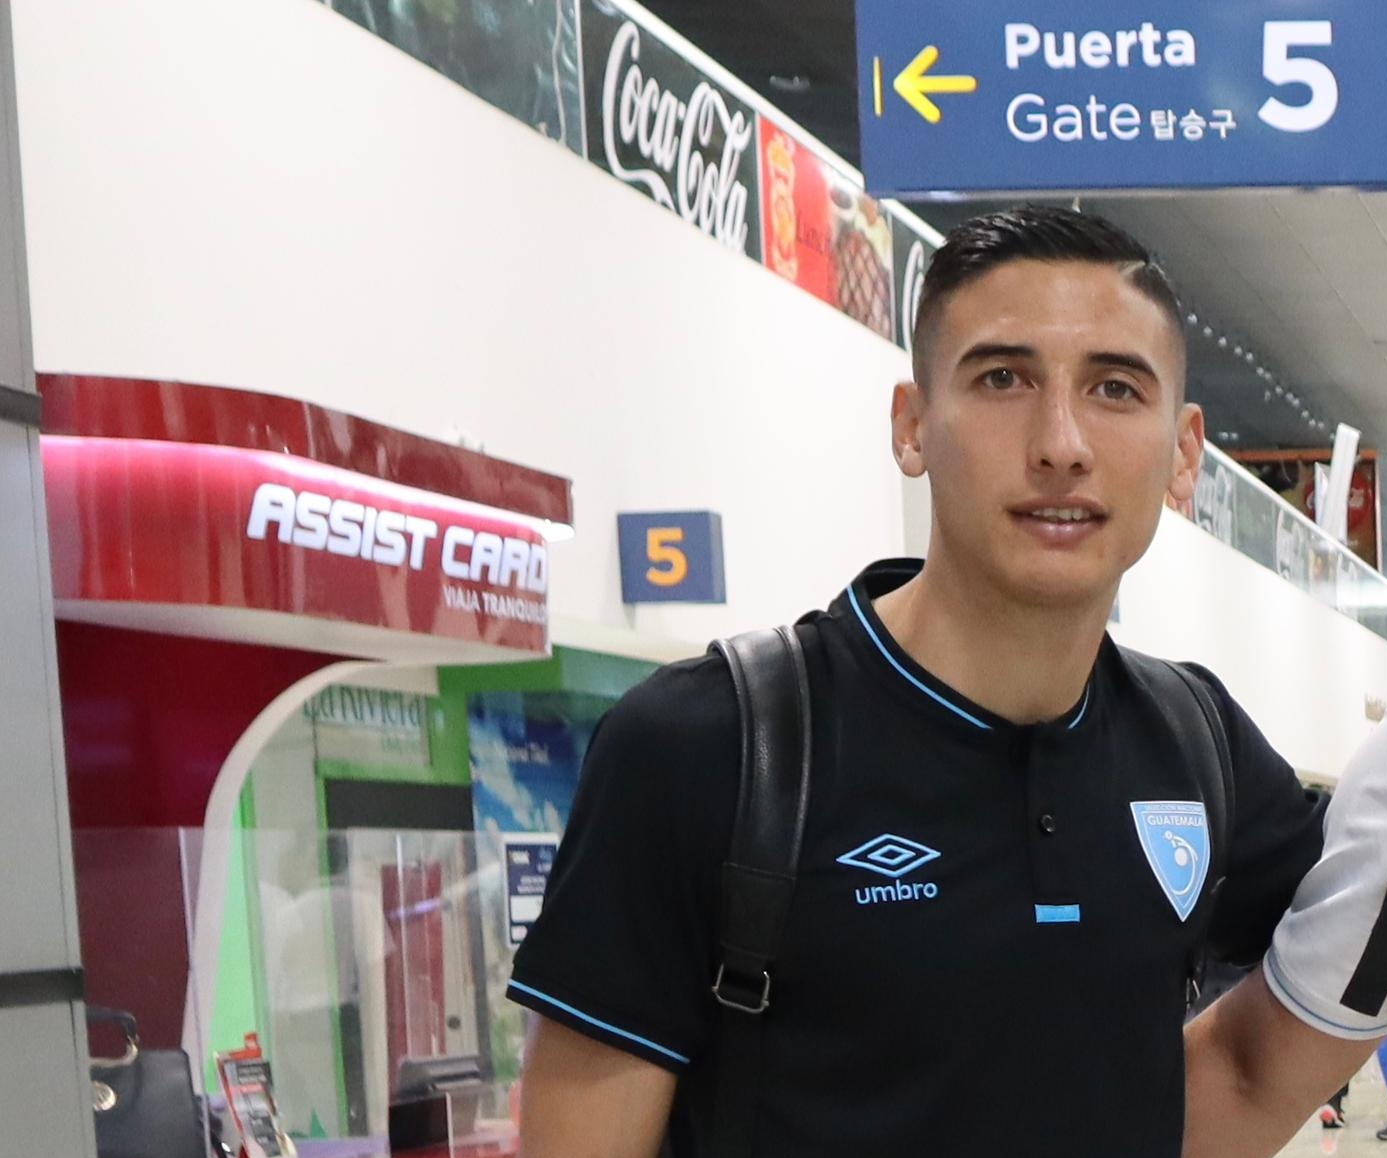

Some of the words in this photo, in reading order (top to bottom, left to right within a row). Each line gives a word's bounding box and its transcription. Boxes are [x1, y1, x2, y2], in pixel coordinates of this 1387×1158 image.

[1004, 22, 1196, 69] Puerta
[1257, 20, 1339, 133] 5
[1006, 94, 1141, 142] Gate
[1150, 108, 1237, 141] 탑승구
[246, 483, 438, 572] ASSIST
[441, 525, 547, 595] CARD
[645, 526, 688, 587] 5
[442, 584, 481, 613] VIAJA
[855, 879, 938, 905] umbro
